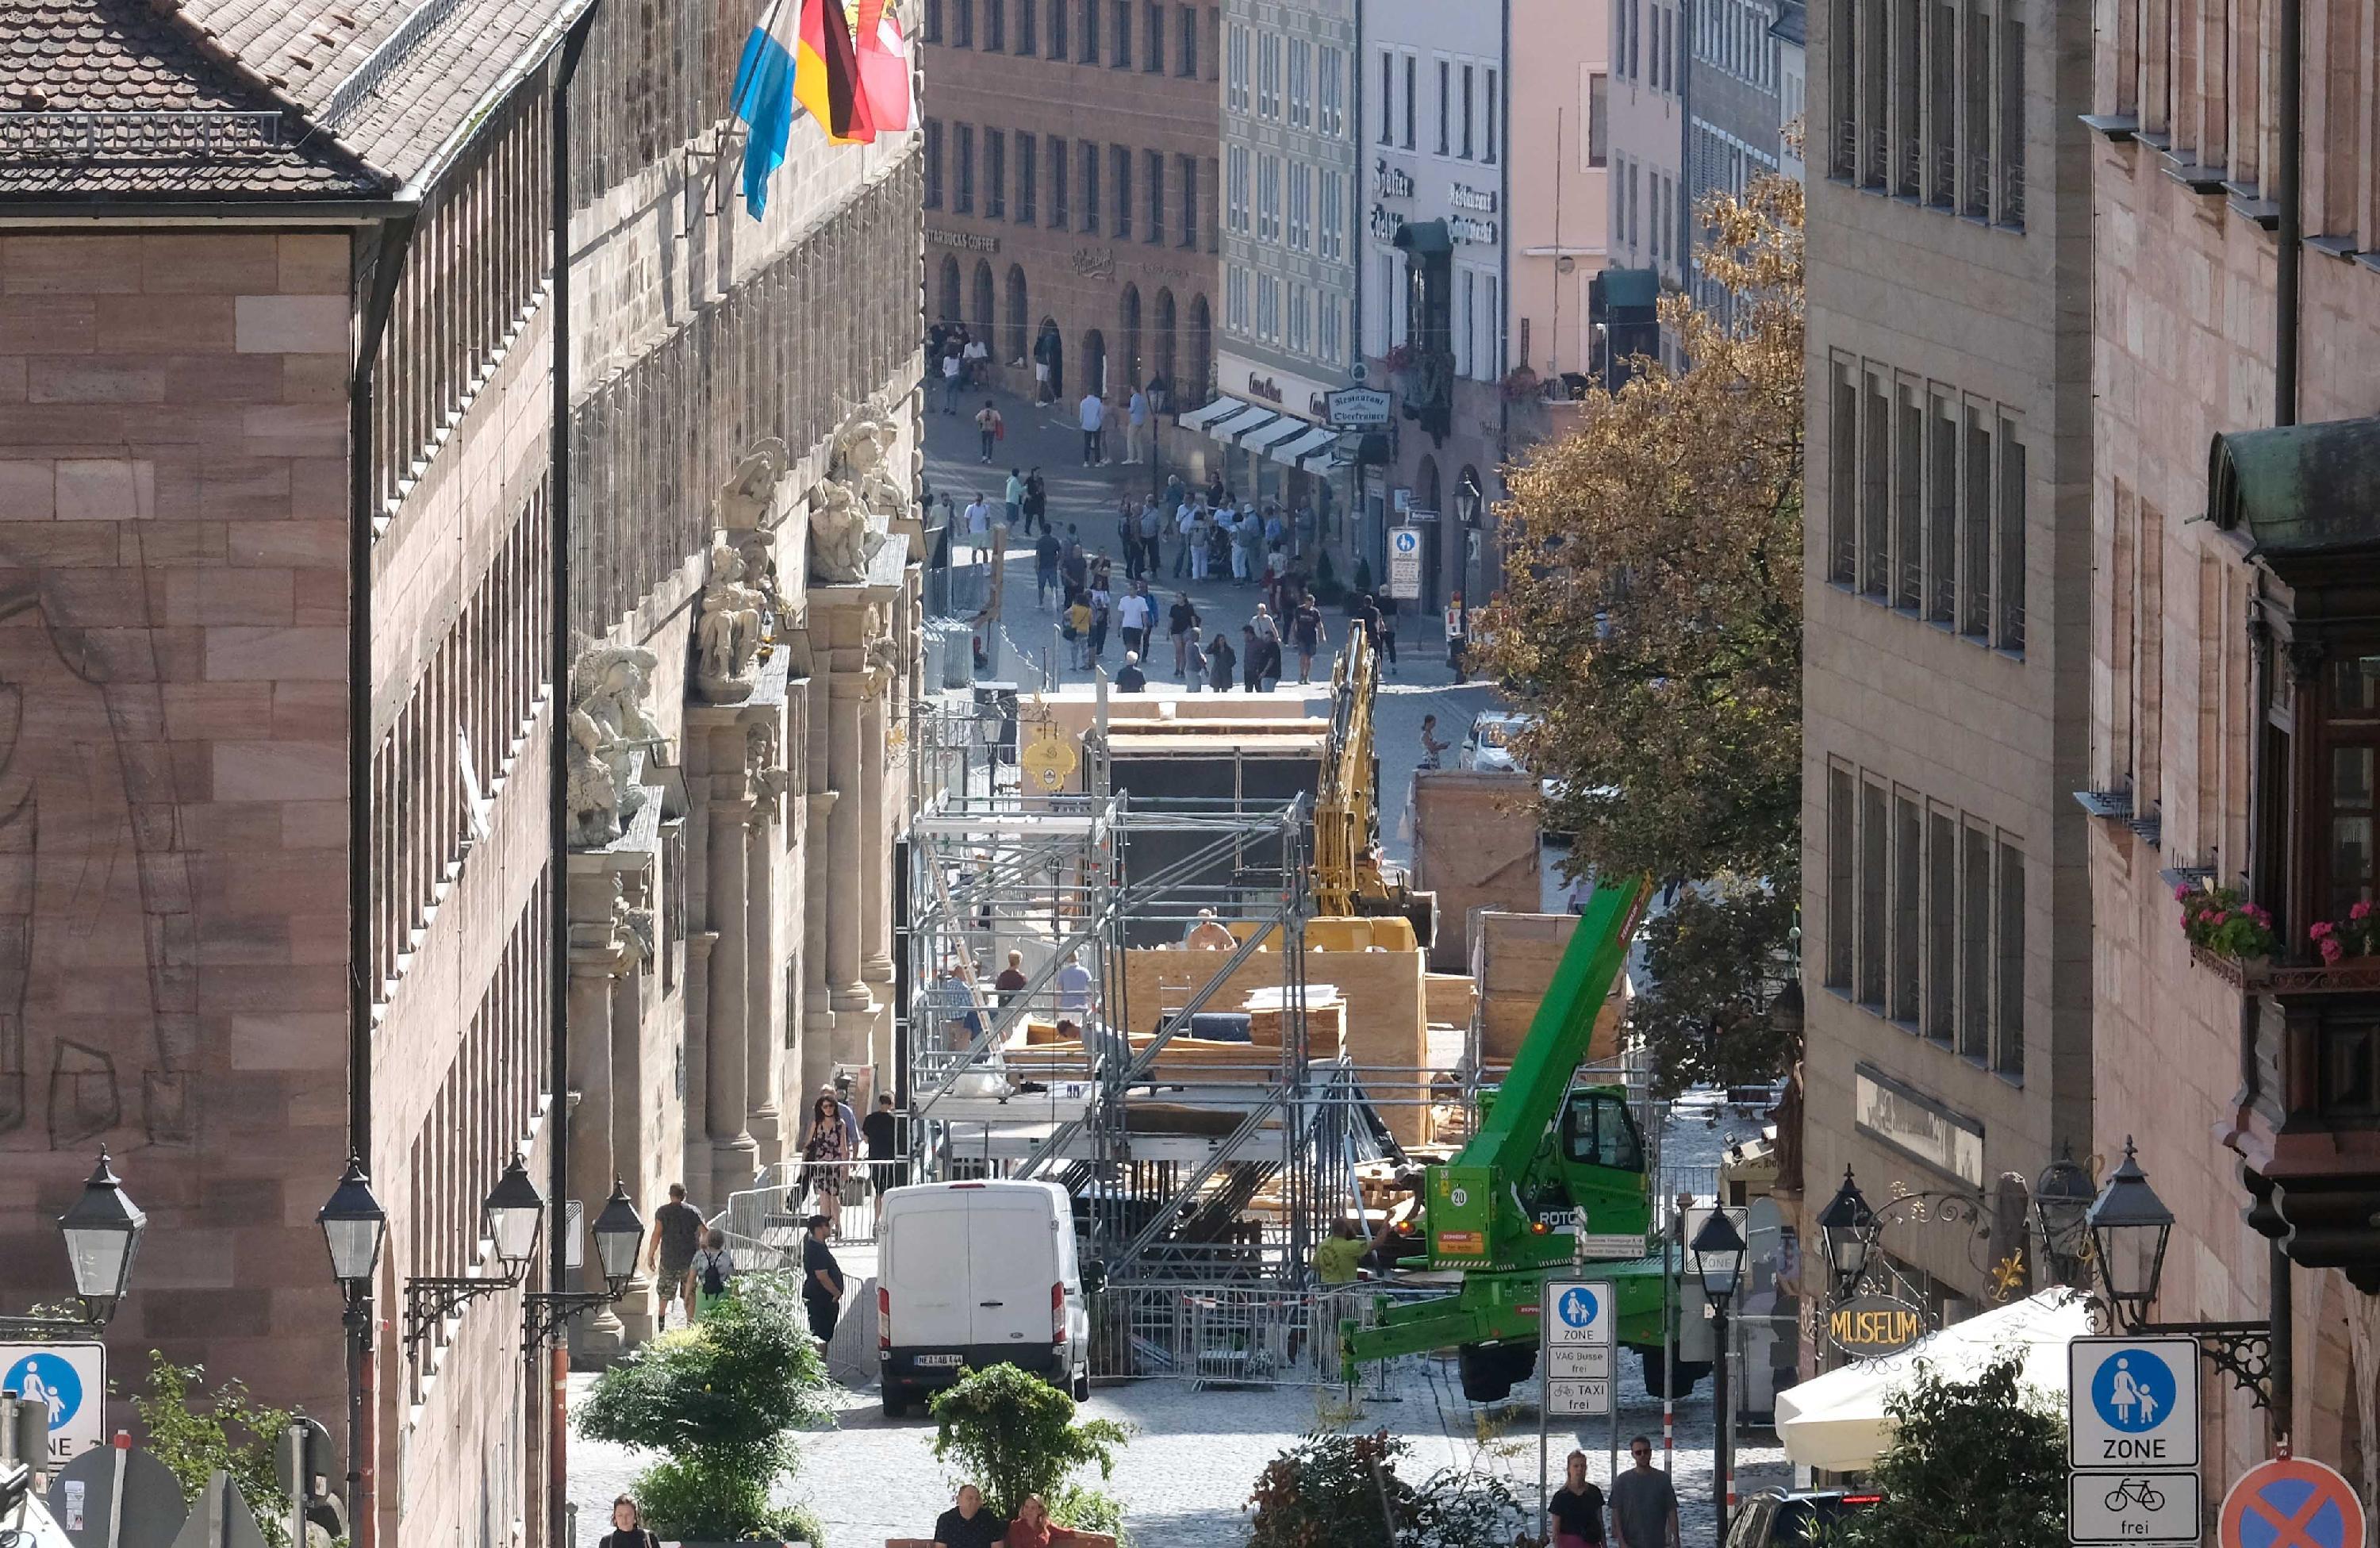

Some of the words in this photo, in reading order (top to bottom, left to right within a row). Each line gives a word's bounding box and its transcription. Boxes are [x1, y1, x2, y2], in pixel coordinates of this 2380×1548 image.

[924, 229, 966, 248] STARBUCKS
[968, 234, 996, 252] COFFEE
[1334, 395, 1384, 406] Restaurant
[1453, 1192, 1465, 1204] 20
[1831, 1311, 1917, 1343] MUSEUM
[1564, 1330, 1594, 1340] ZONE
[1556, 1351, 1574, 1361] VAG
[1576, 1351, 1603, 1361] Busse
[1572, 1364, 1587, 1373] frei
[1578, 1385, 1604, 1396] TAXI
[1568, 1400, 1589, 1410] frei
[48, 1438, 72, 1456] NE
[2103, 1439, 2167, 1458] ZONE
[2121, 1520, 2149, 1535] frei
